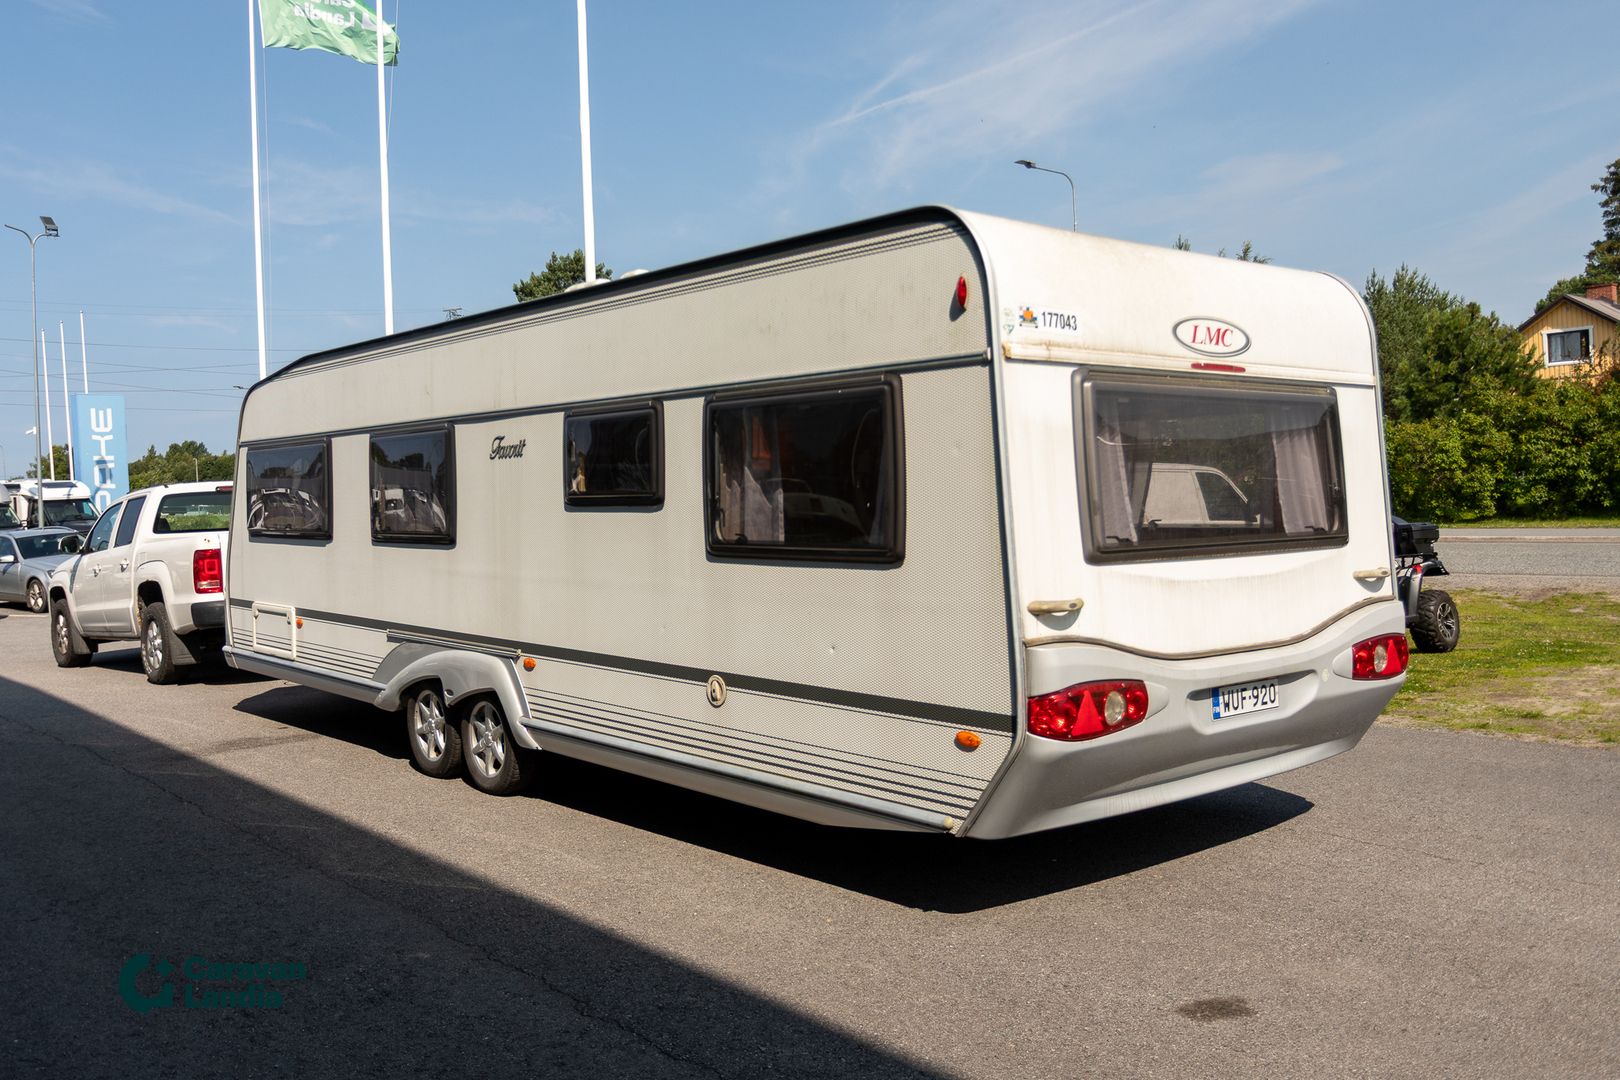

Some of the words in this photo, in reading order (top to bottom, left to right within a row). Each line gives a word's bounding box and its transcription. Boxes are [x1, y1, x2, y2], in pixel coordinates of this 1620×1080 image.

[1041, 311, 1077, 331] 177043
[1191, 325, 1233, 347] LMC
[1222, 683, 1276, 713] WUF-920
